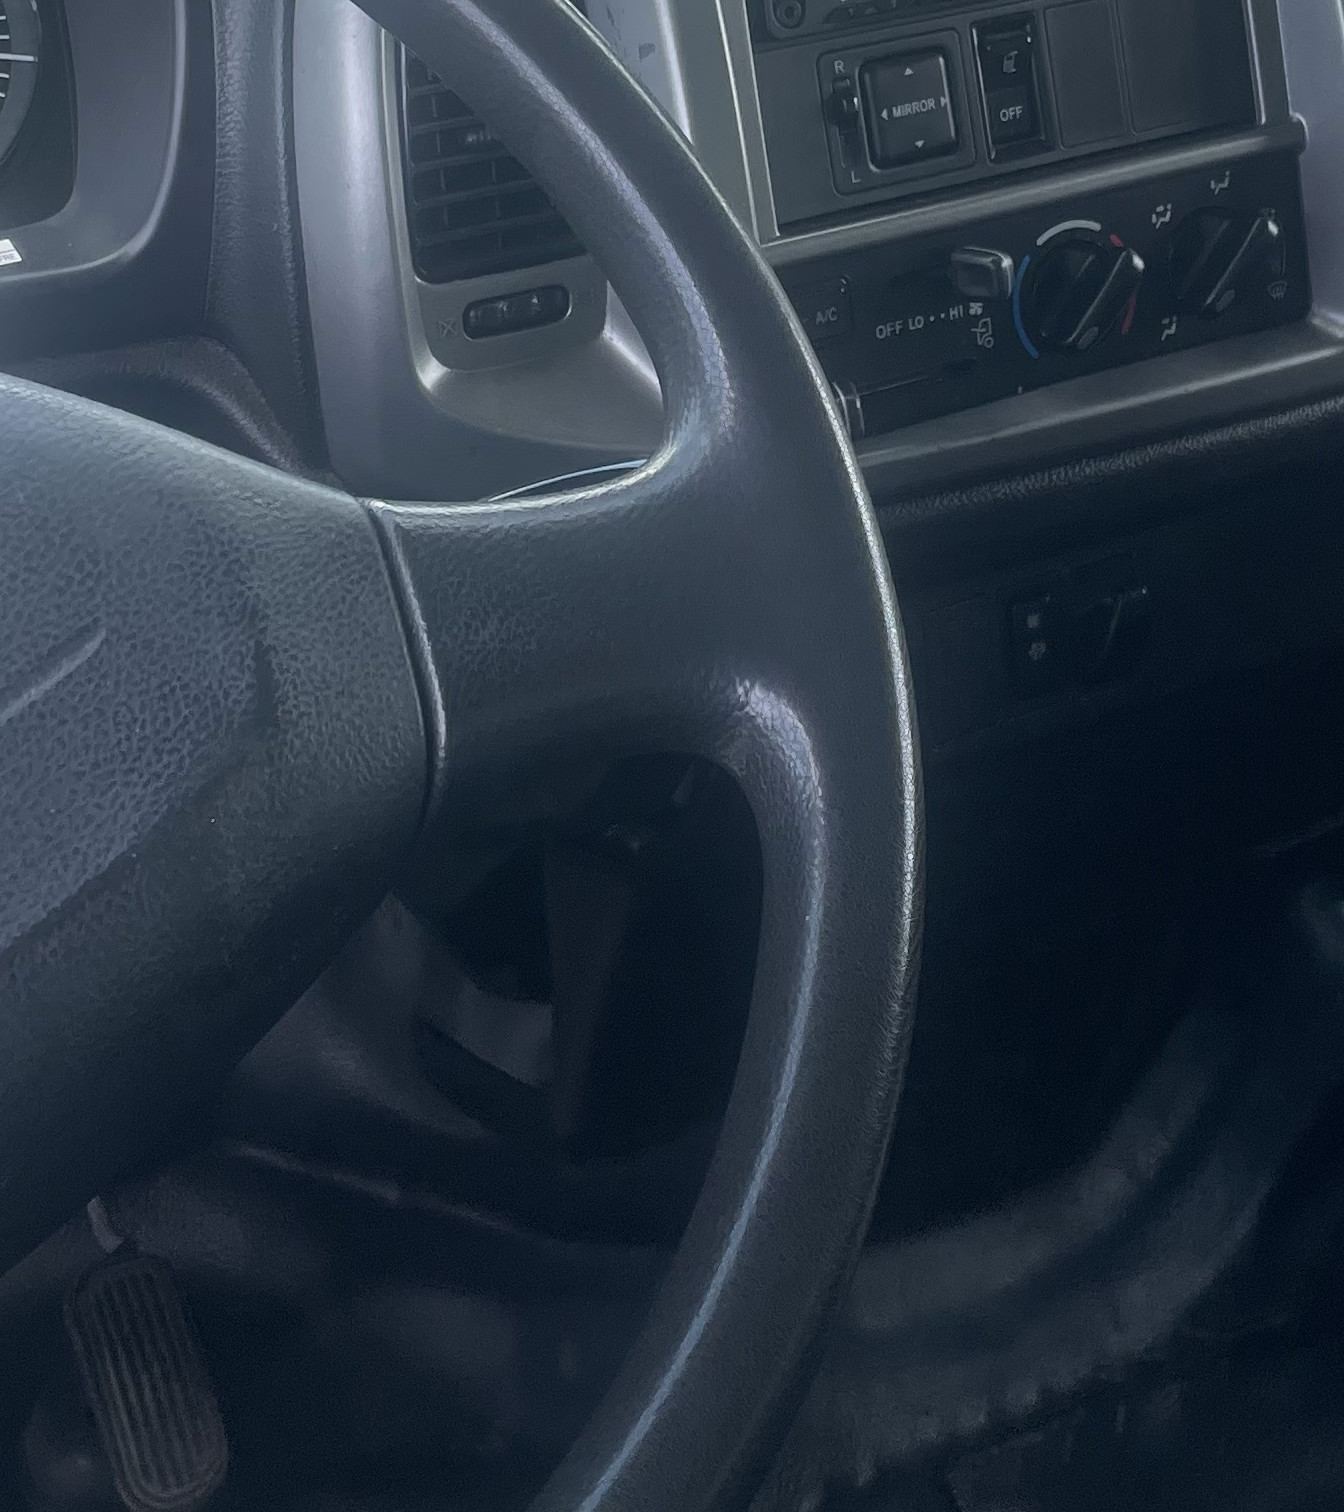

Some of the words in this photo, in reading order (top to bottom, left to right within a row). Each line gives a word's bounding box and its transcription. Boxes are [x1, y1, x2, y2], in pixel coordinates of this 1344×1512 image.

[834, 59, 844, 74] R
[892, 97, 937, 119] MIRROR
[999, 106, 1023, 122] OFF
[851, 171, 861, 184] L
[815, 306, 838, 325] A/C
[875, 320, 904, 339] OFF
[908, 315, 924, 330] LO
[949, 305, 964, 320] HI
